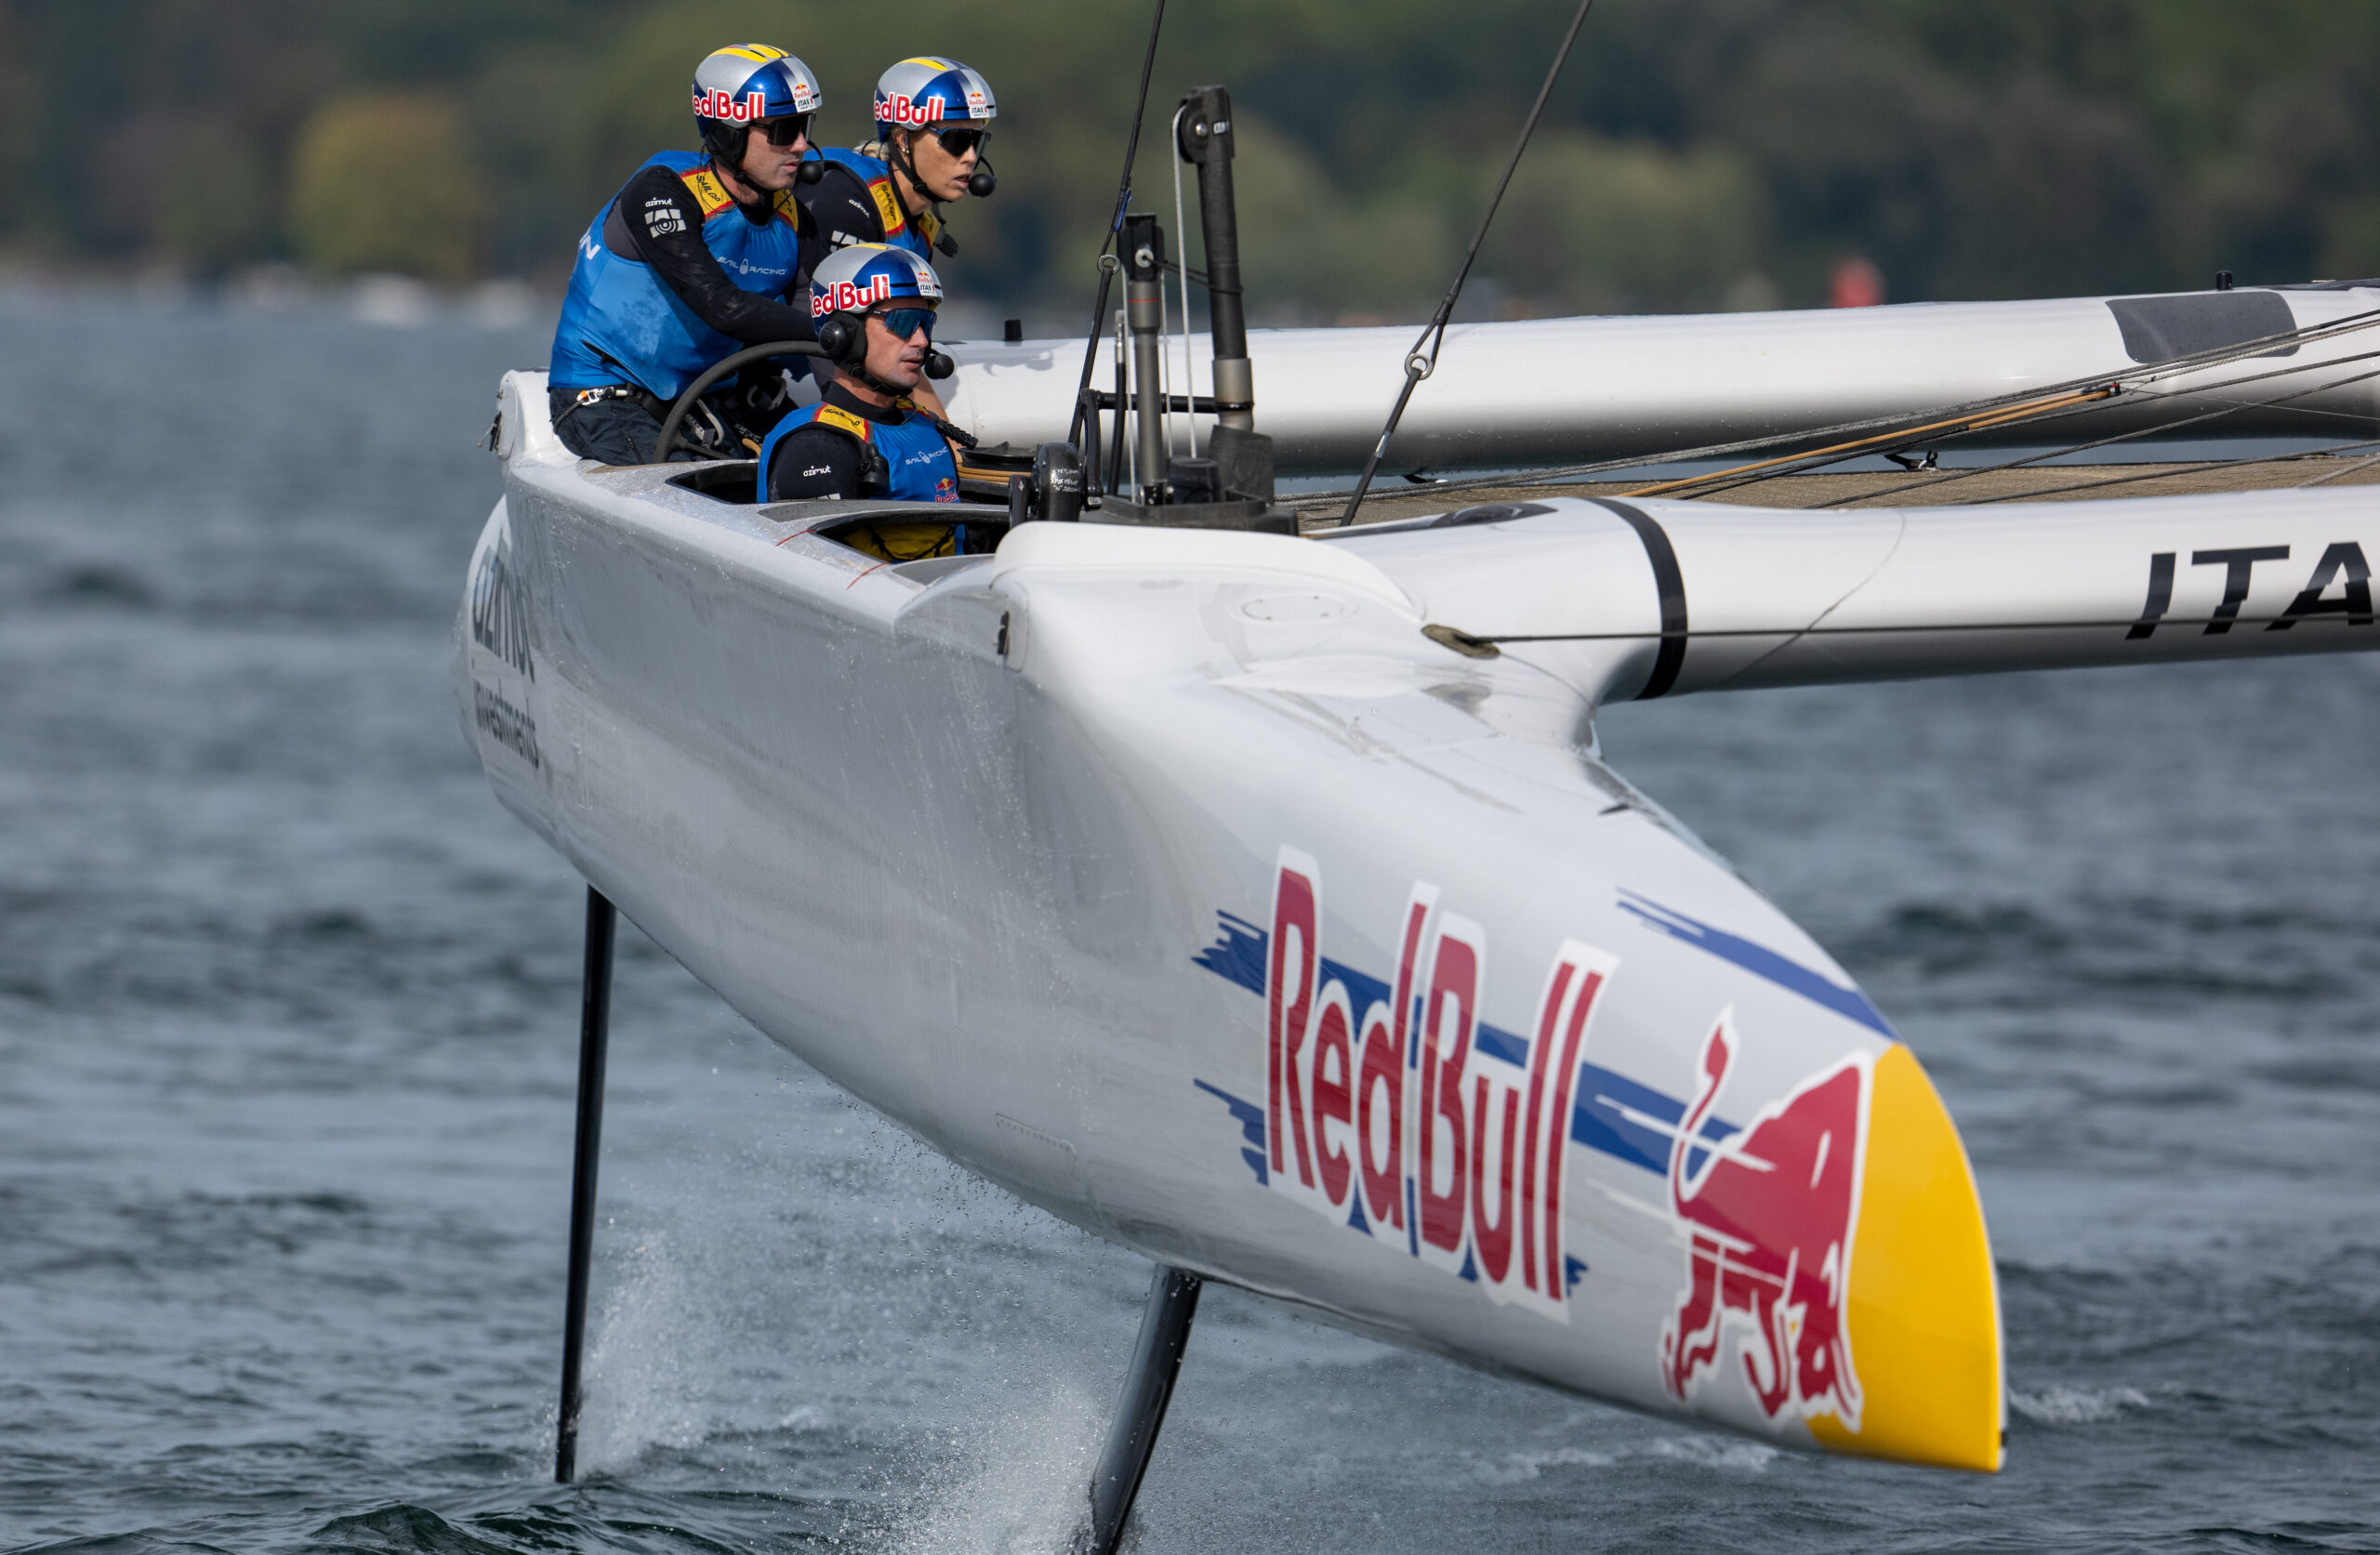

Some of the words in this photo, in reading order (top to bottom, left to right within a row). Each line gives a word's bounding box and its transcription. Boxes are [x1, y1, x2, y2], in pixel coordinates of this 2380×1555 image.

[692, 85, 715, 118] ed
[716, 90, 765, 122] Bull
[874, 91, 894, 122] ed
[895, 95, 945, 125] Bull
[645, 197, 673, 207] azimut
[717, 256, 739, 270] SAIL
[748, 266, 787, 276] RACING
[838, 273, 892, 310] Bull
[803, 465, 832, 477] azimut
[2125, 541, 2374, 640] ITA
[1266, 860, 1434, 1241] Red
[1419, 920, 1610, 1312] Bull
